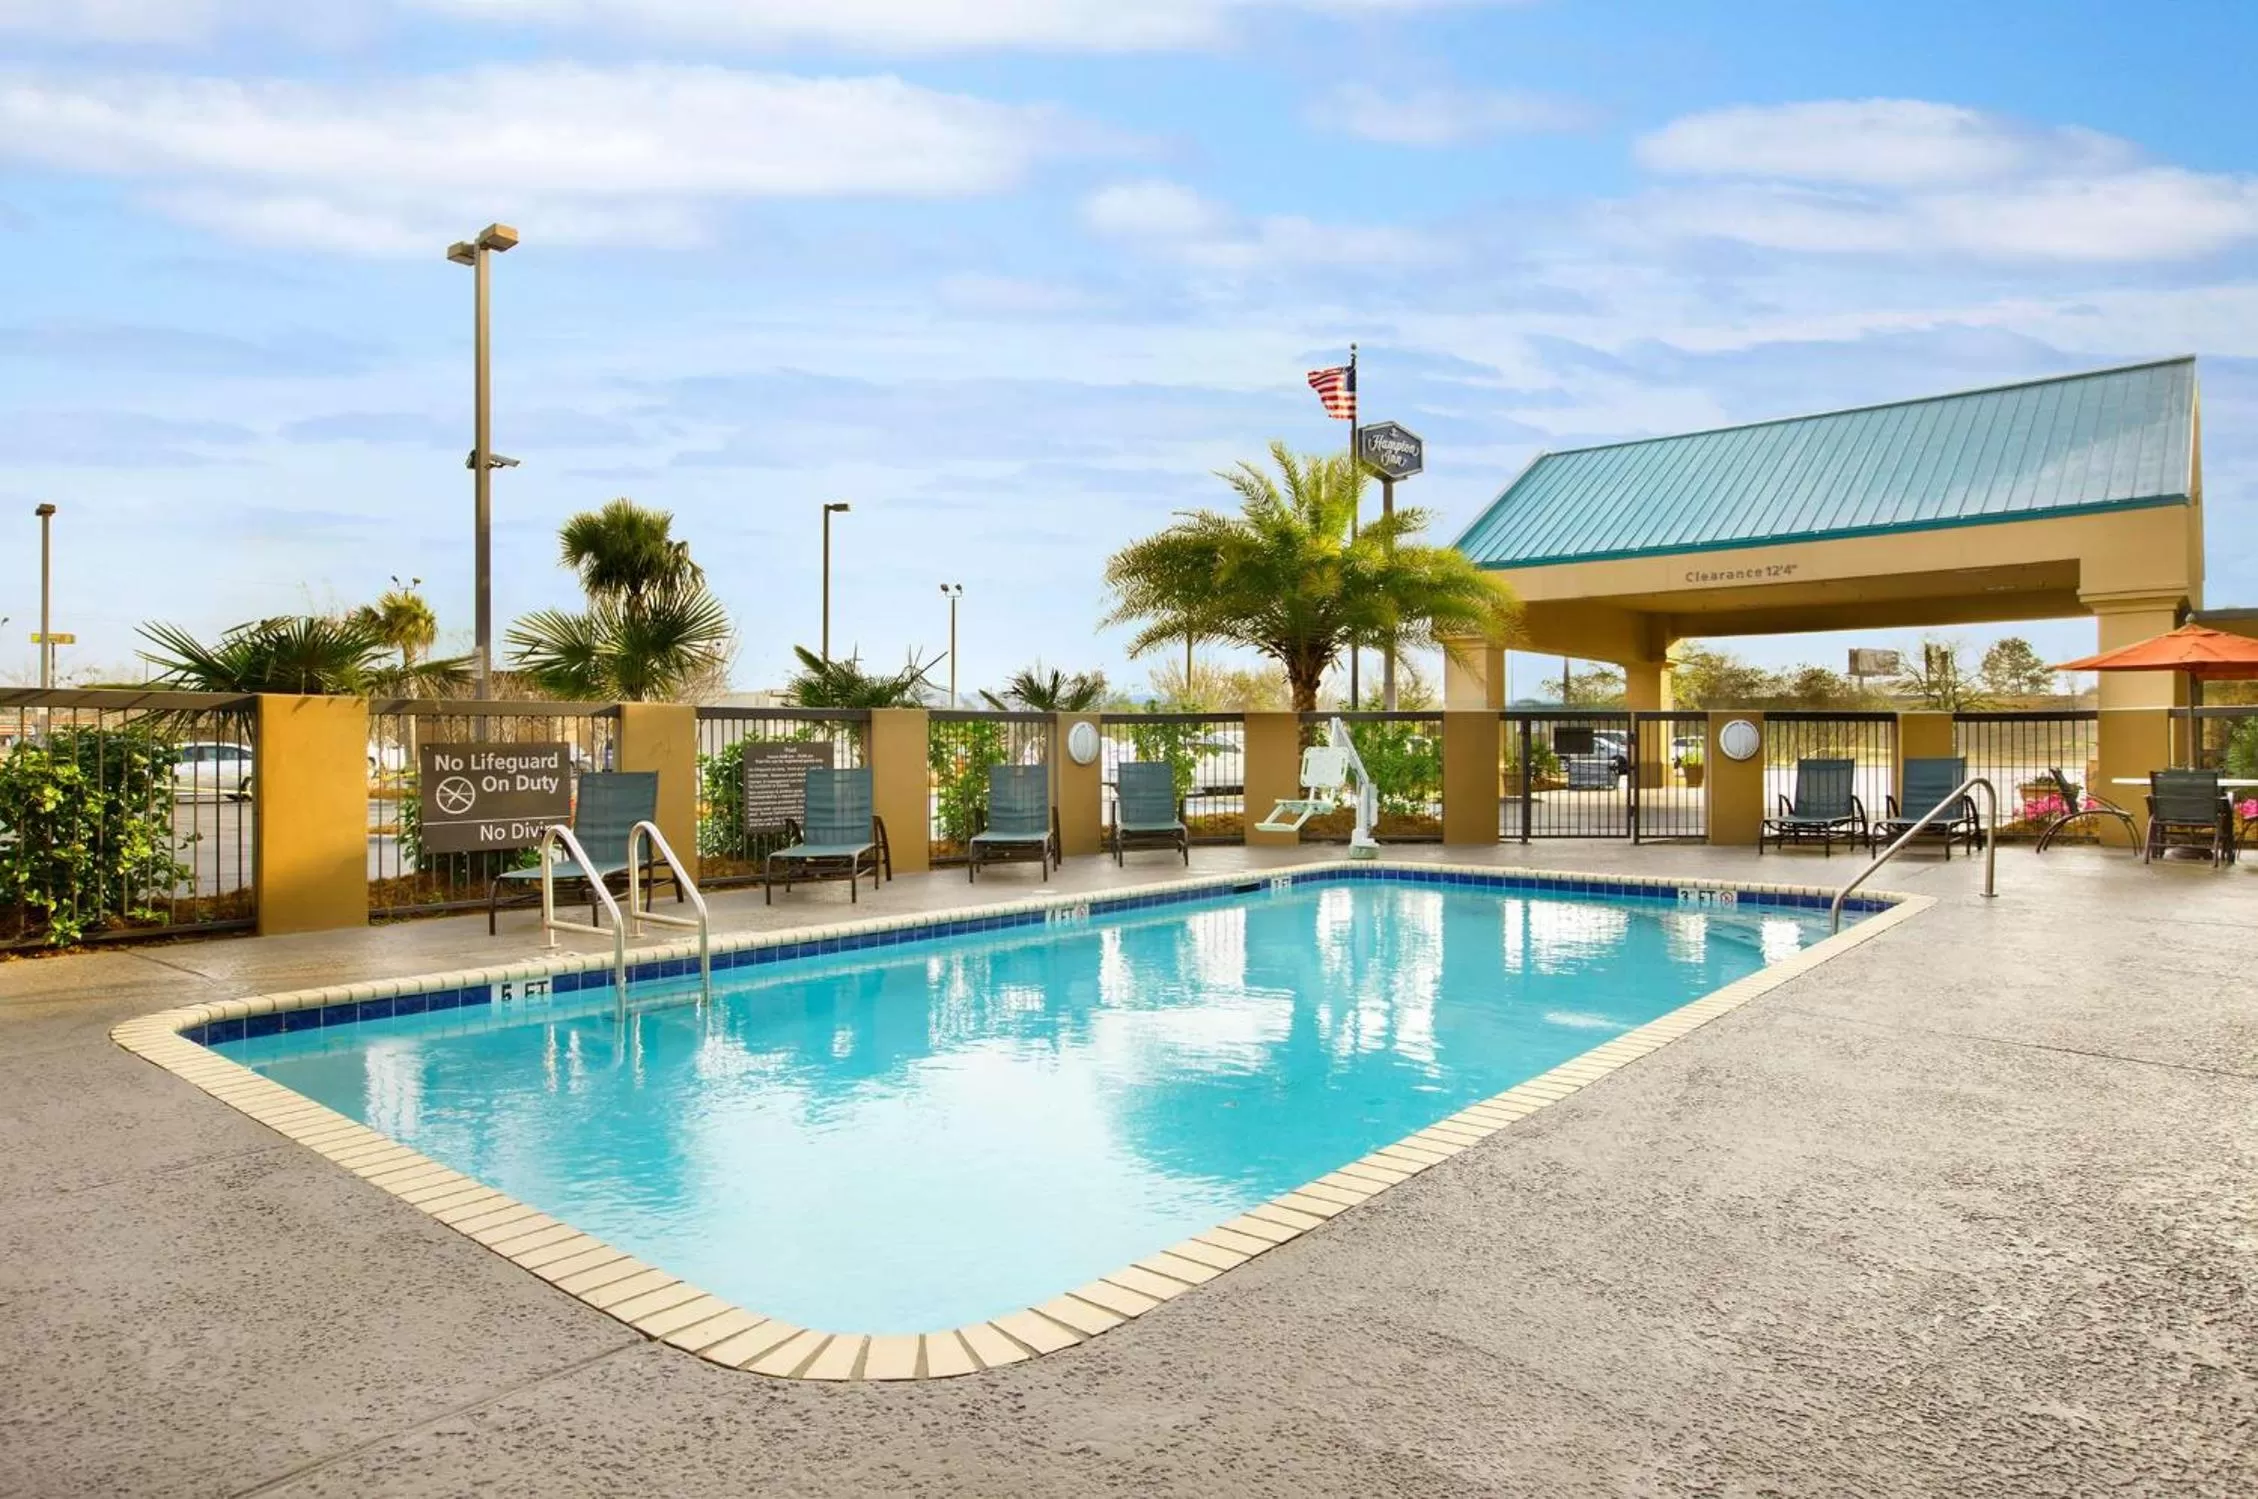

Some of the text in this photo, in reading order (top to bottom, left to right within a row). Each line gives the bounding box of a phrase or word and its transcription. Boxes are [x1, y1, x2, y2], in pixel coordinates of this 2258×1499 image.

[1367, 434, 1419, 456] Hampton
[1381, 450, 1407, 467] Inn
[1685, 570, 1763, 582] Clearance
[434, 752, 559, 773] No Lifeguard
[481, 775, 559, 794] On Duty
[480, 824, 506, 841] No
[1699, 890, 1717, 903] FT
[501, 980, 549, 1001] 5 FT
